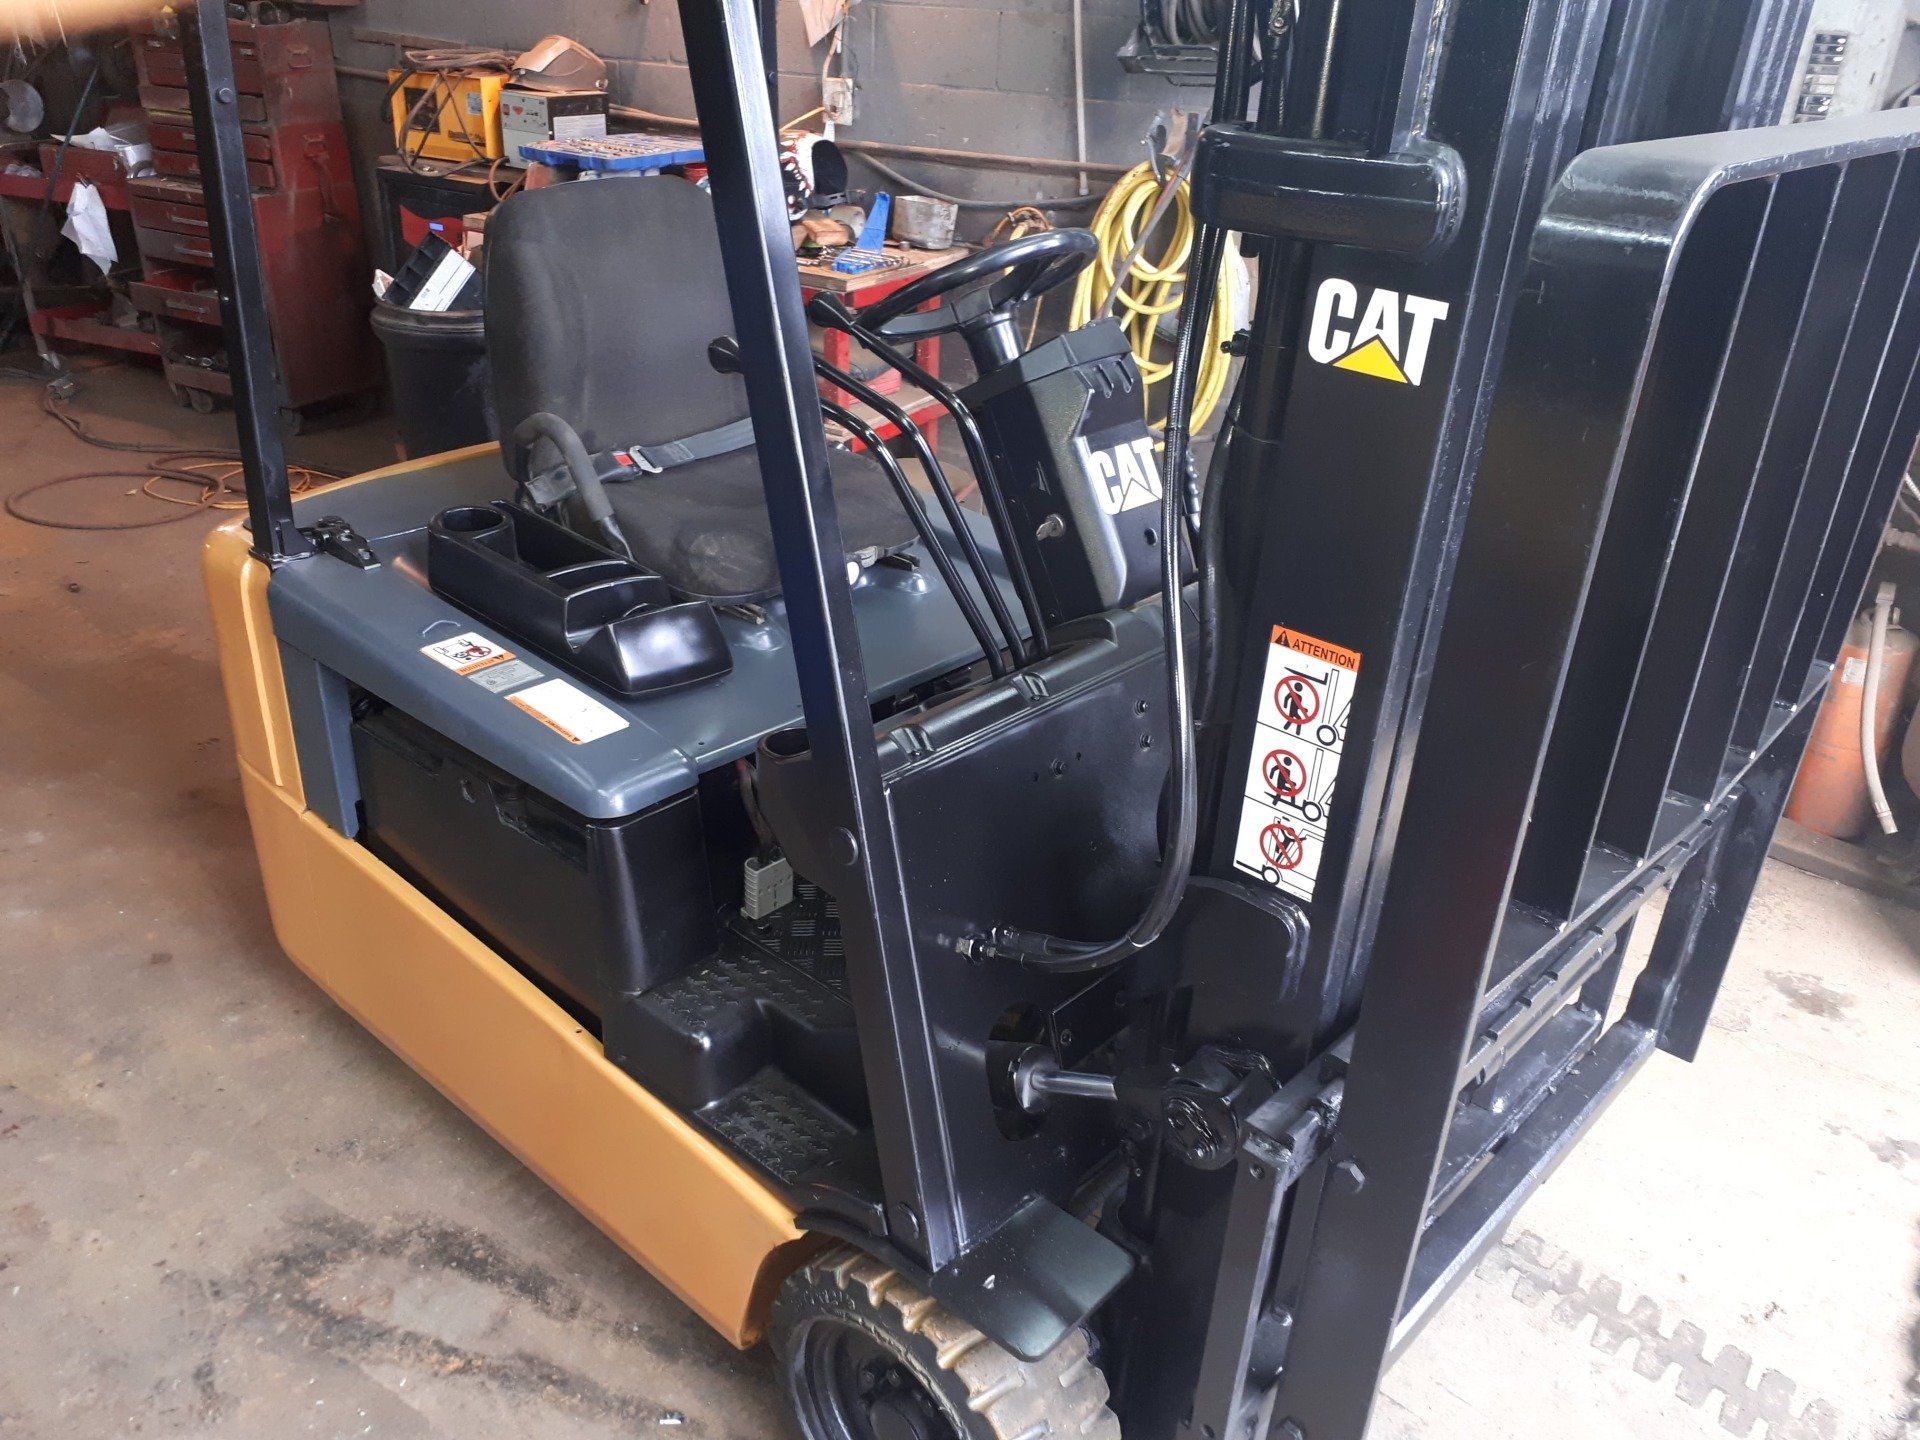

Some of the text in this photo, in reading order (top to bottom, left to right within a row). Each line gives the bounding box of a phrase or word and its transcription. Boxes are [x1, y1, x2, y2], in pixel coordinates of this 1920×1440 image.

[1308, 278, 1449, 386] CAT
[1088, 437, 1162, 515] CAT
[1292, 638, 1356, 669] ATTENTION
